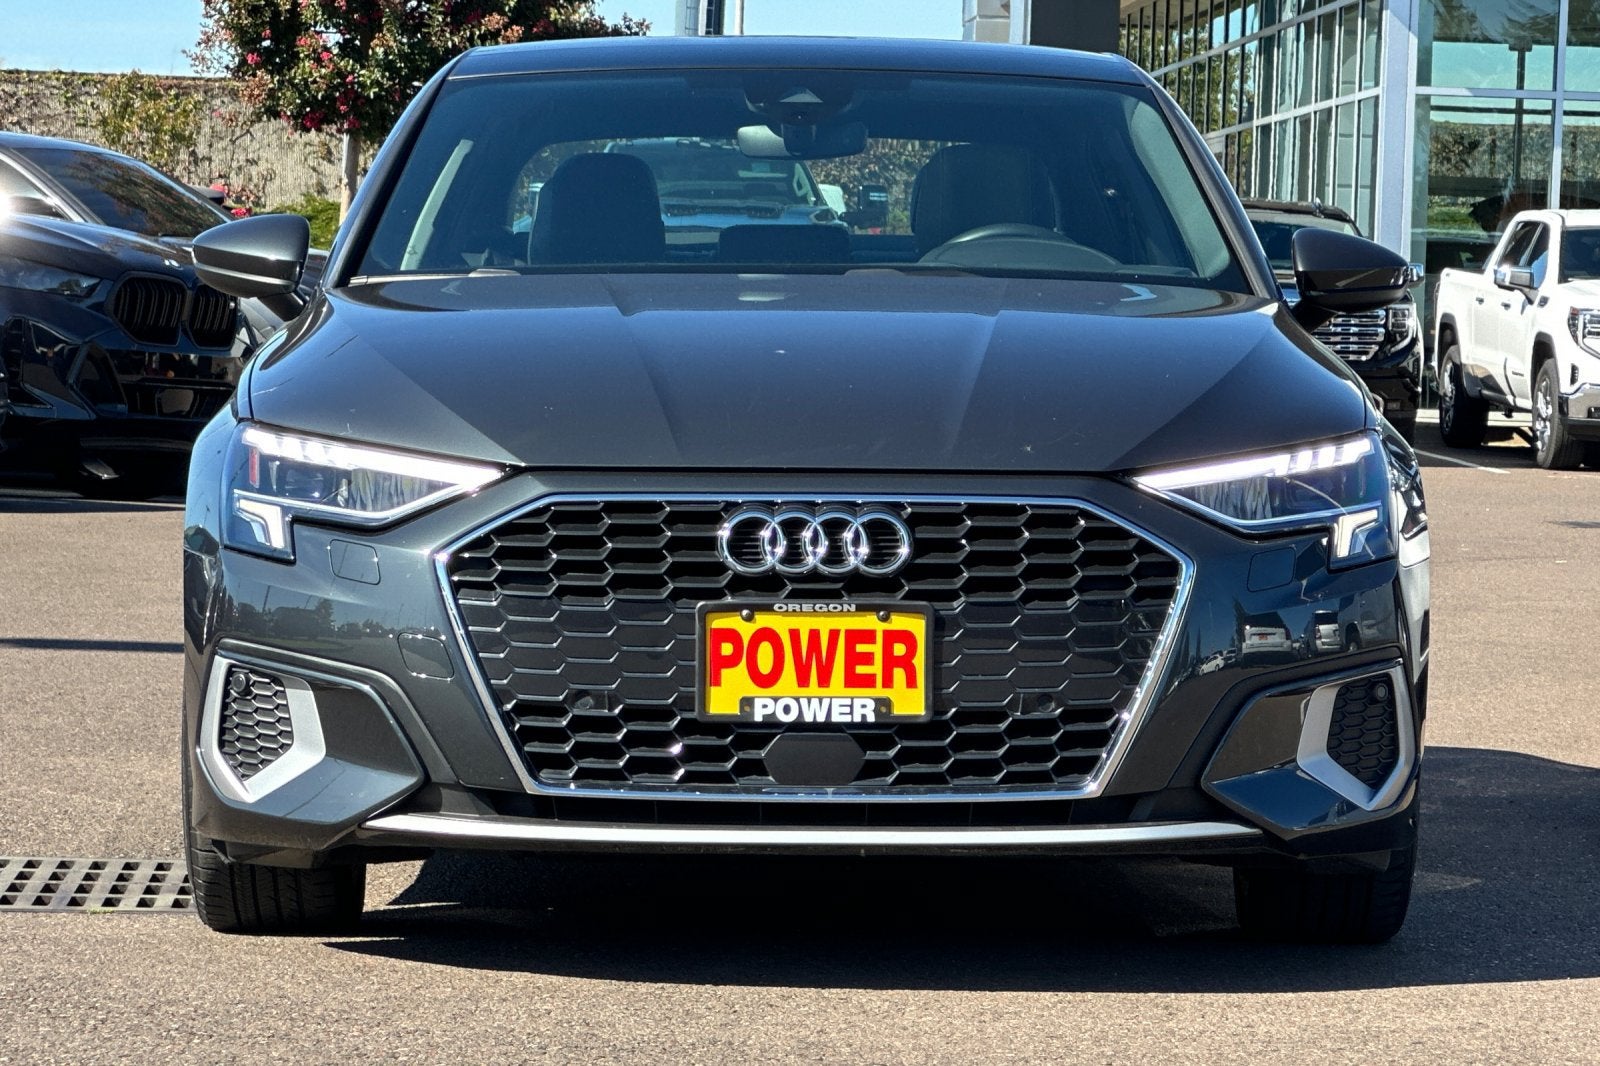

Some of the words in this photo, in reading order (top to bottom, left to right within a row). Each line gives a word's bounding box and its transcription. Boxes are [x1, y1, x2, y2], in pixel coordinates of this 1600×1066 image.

[773, 603, 856, 612] OREGON
[710, 627, 918, 689] POWER
[754, 697, 876, 722] POWER
